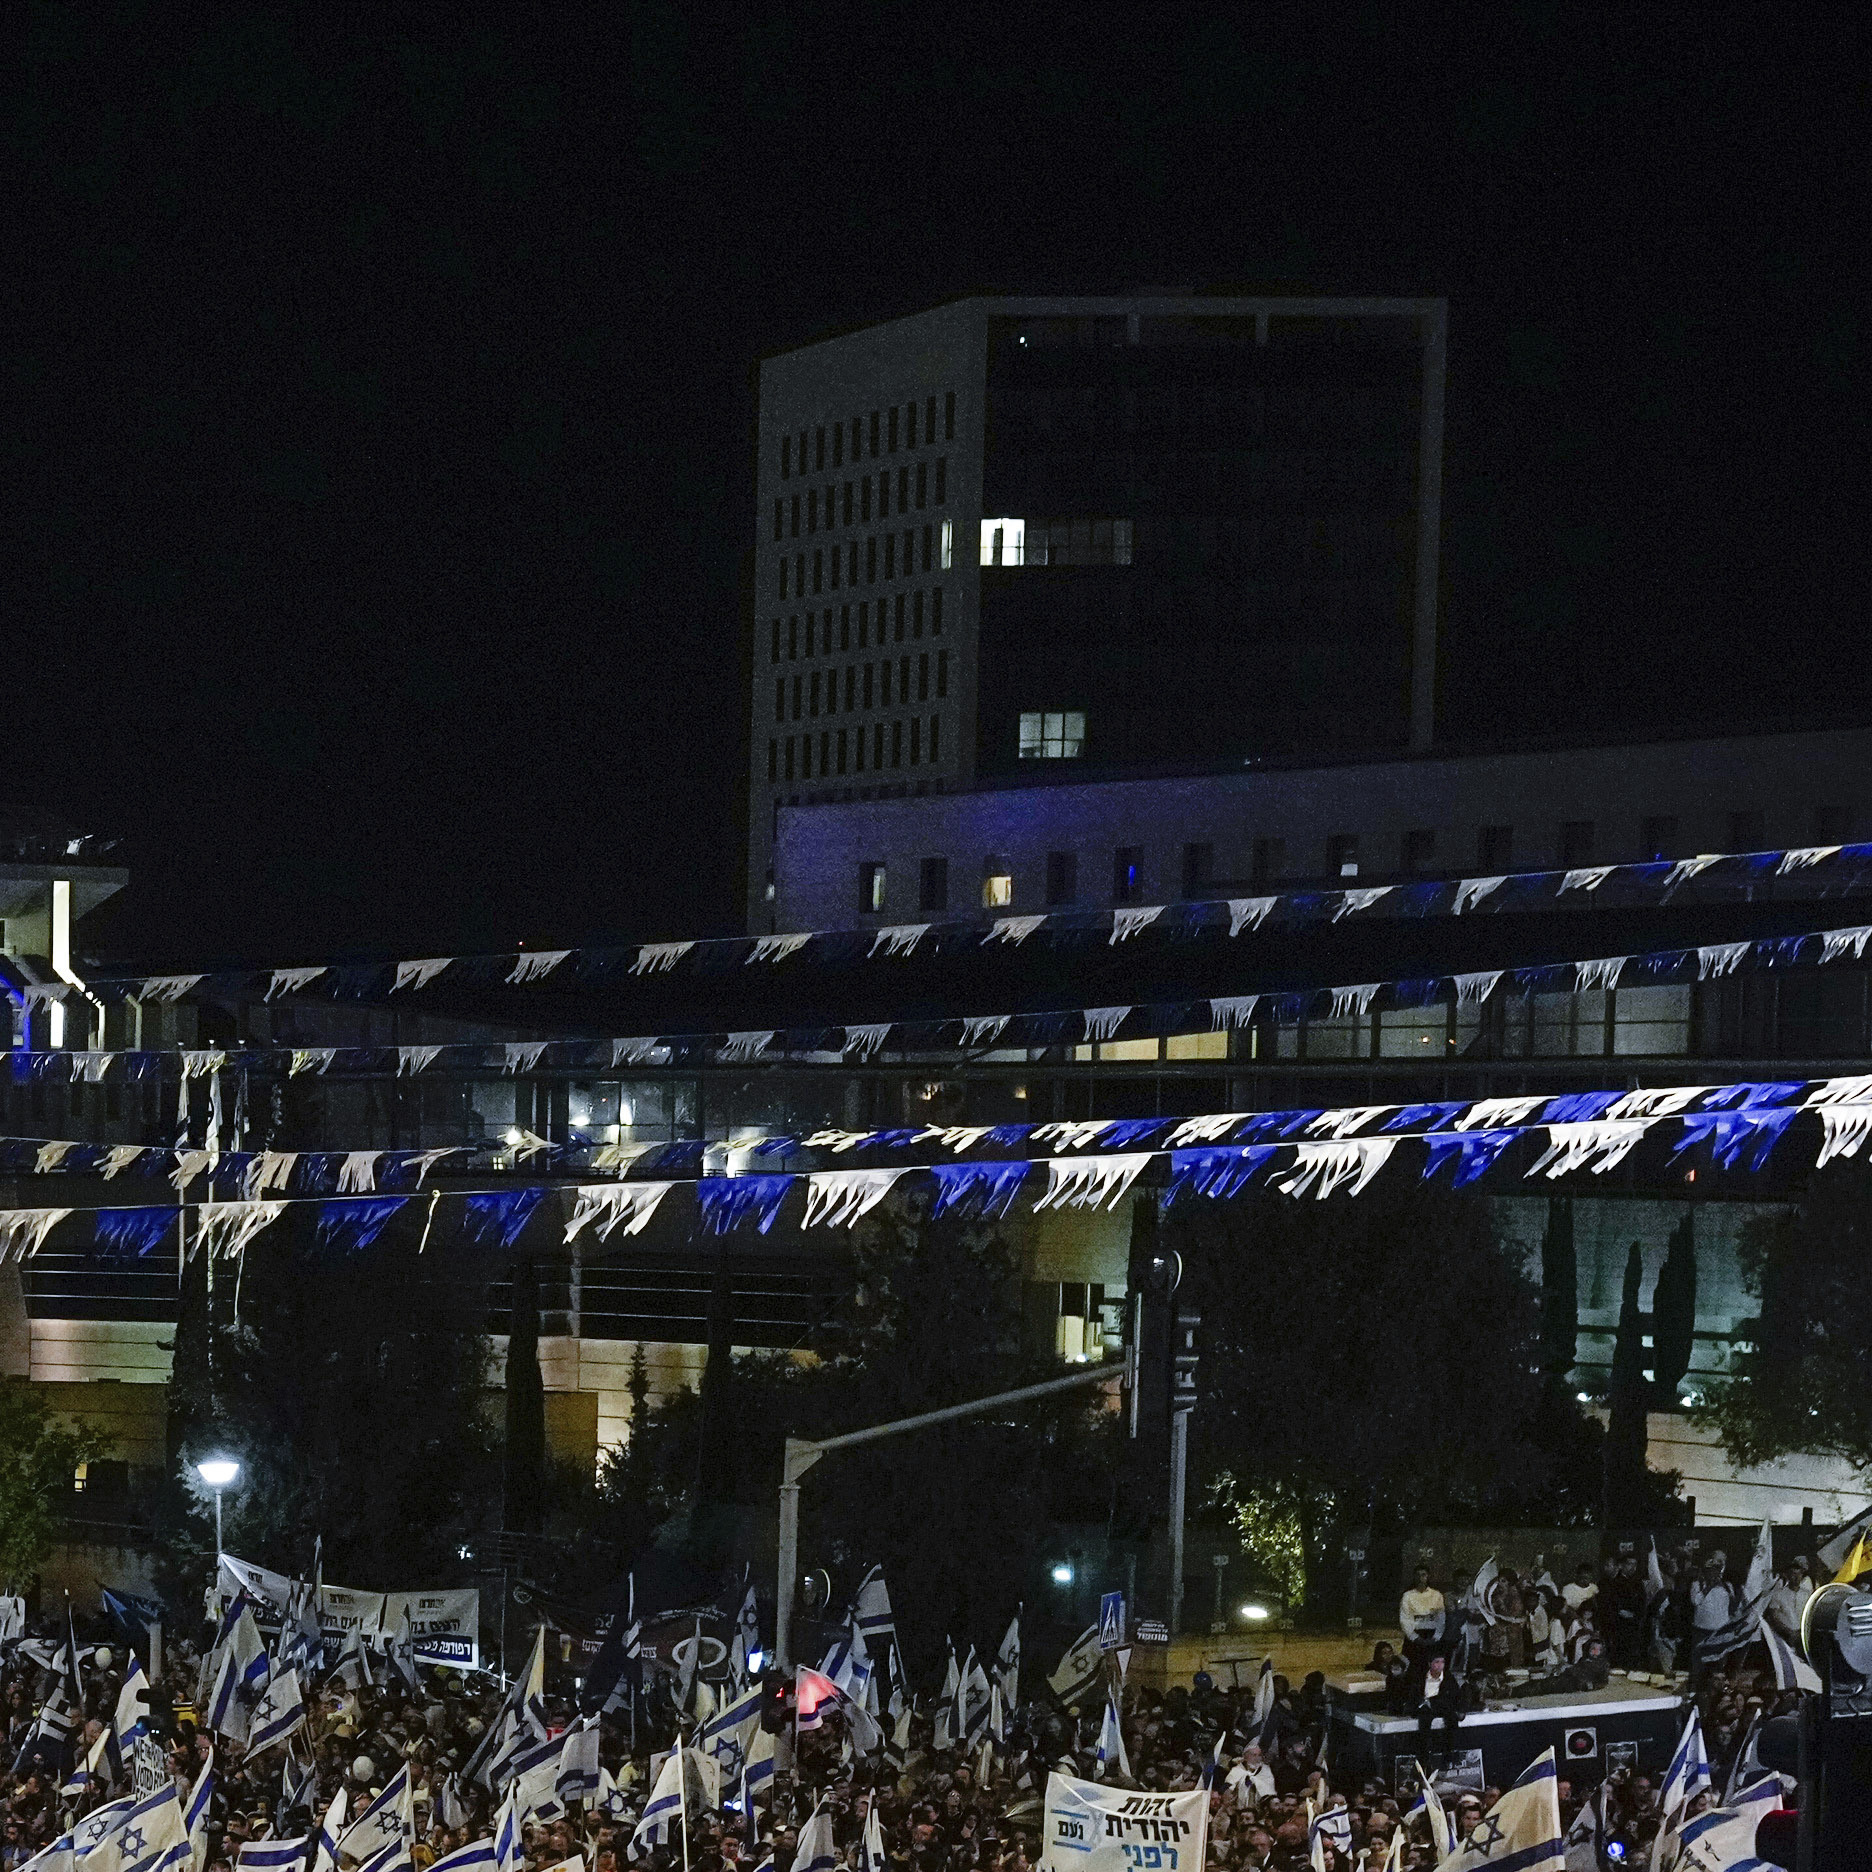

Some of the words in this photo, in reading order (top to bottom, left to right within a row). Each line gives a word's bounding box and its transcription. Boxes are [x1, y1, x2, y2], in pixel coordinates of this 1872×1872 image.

[1117, 1796, 1176, 1818] זהות
[1105, 1813, 1190, 1842] יהודית
[1121, 1841, 1178, 1870] לפני
